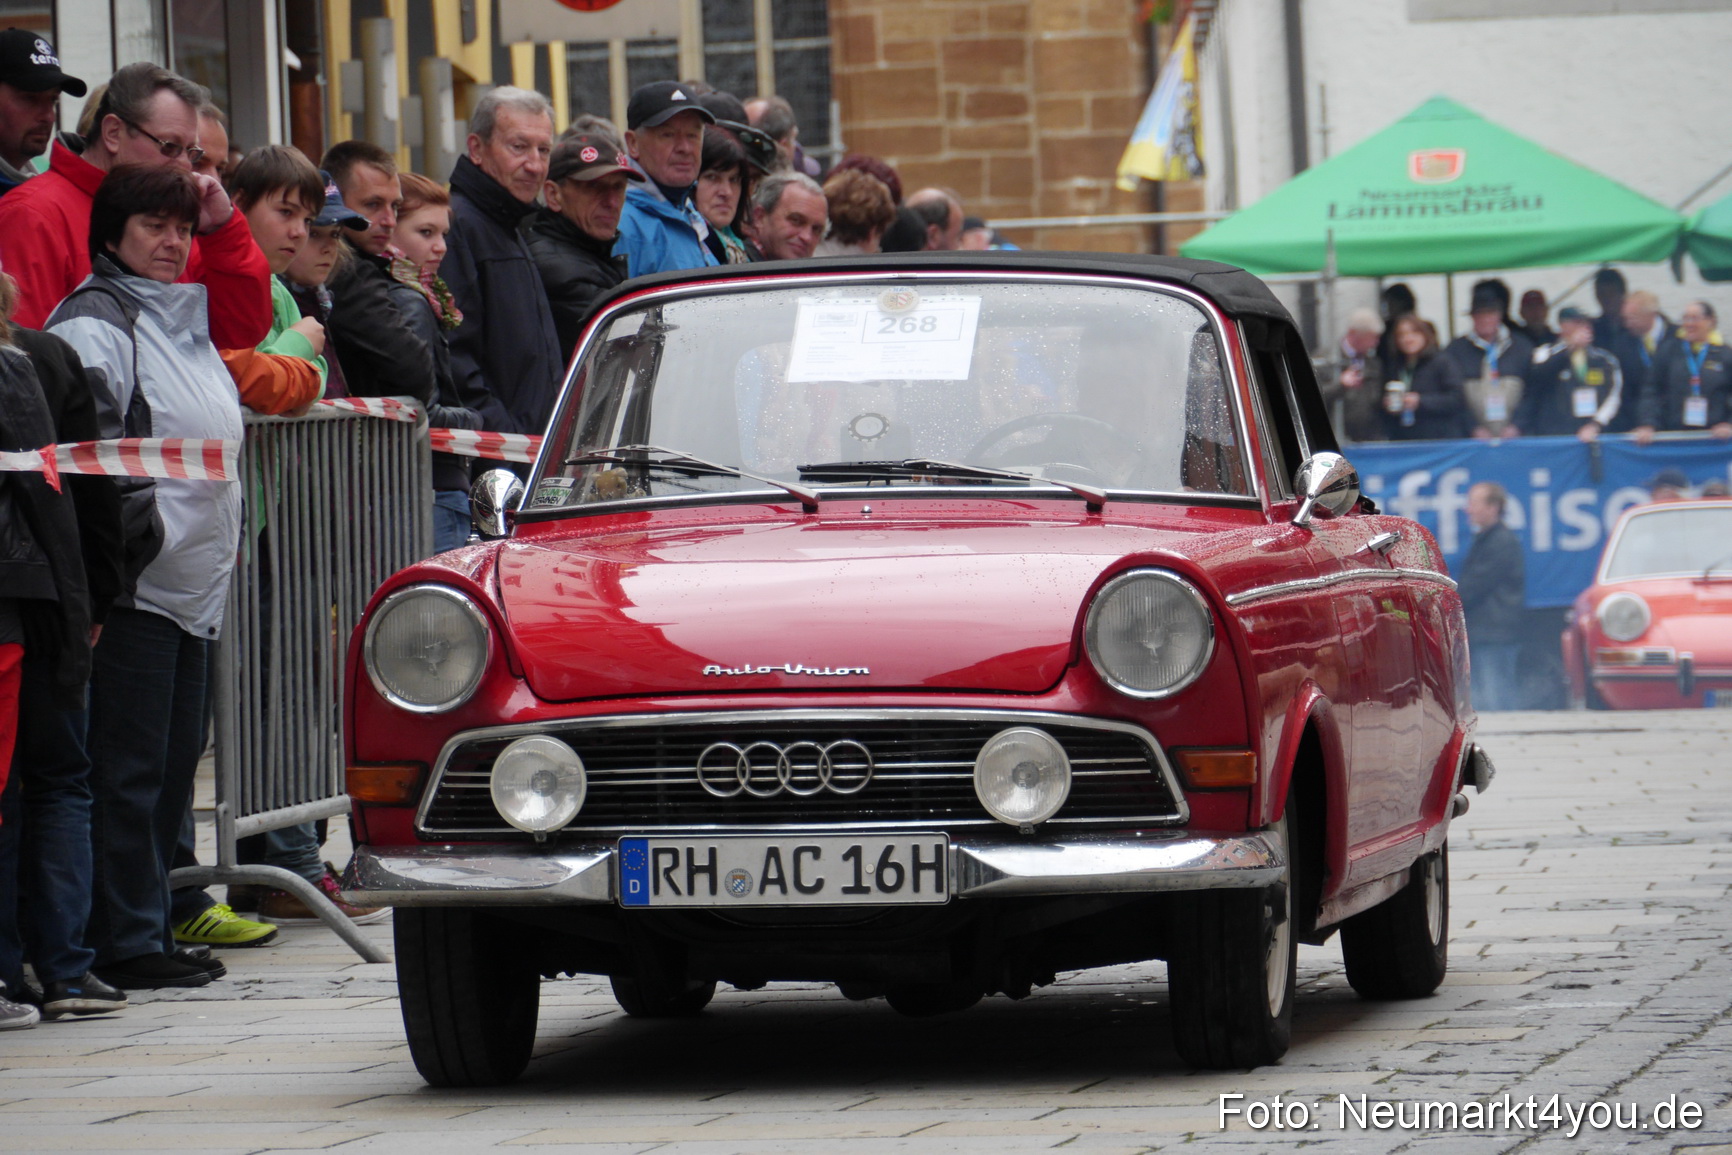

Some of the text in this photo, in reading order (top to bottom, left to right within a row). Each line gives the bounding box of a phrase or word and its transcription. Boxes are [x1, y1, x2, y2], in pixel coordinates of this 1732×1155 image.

[877, 315, 938, 335] 268
[702, 663, 870, 676] Auto Union
[651, 846, 718, 897] RH
[758, 845, 826, 896] AC
[841, 843, 945, 895] 16H
[629, 879, 641, 894] D
